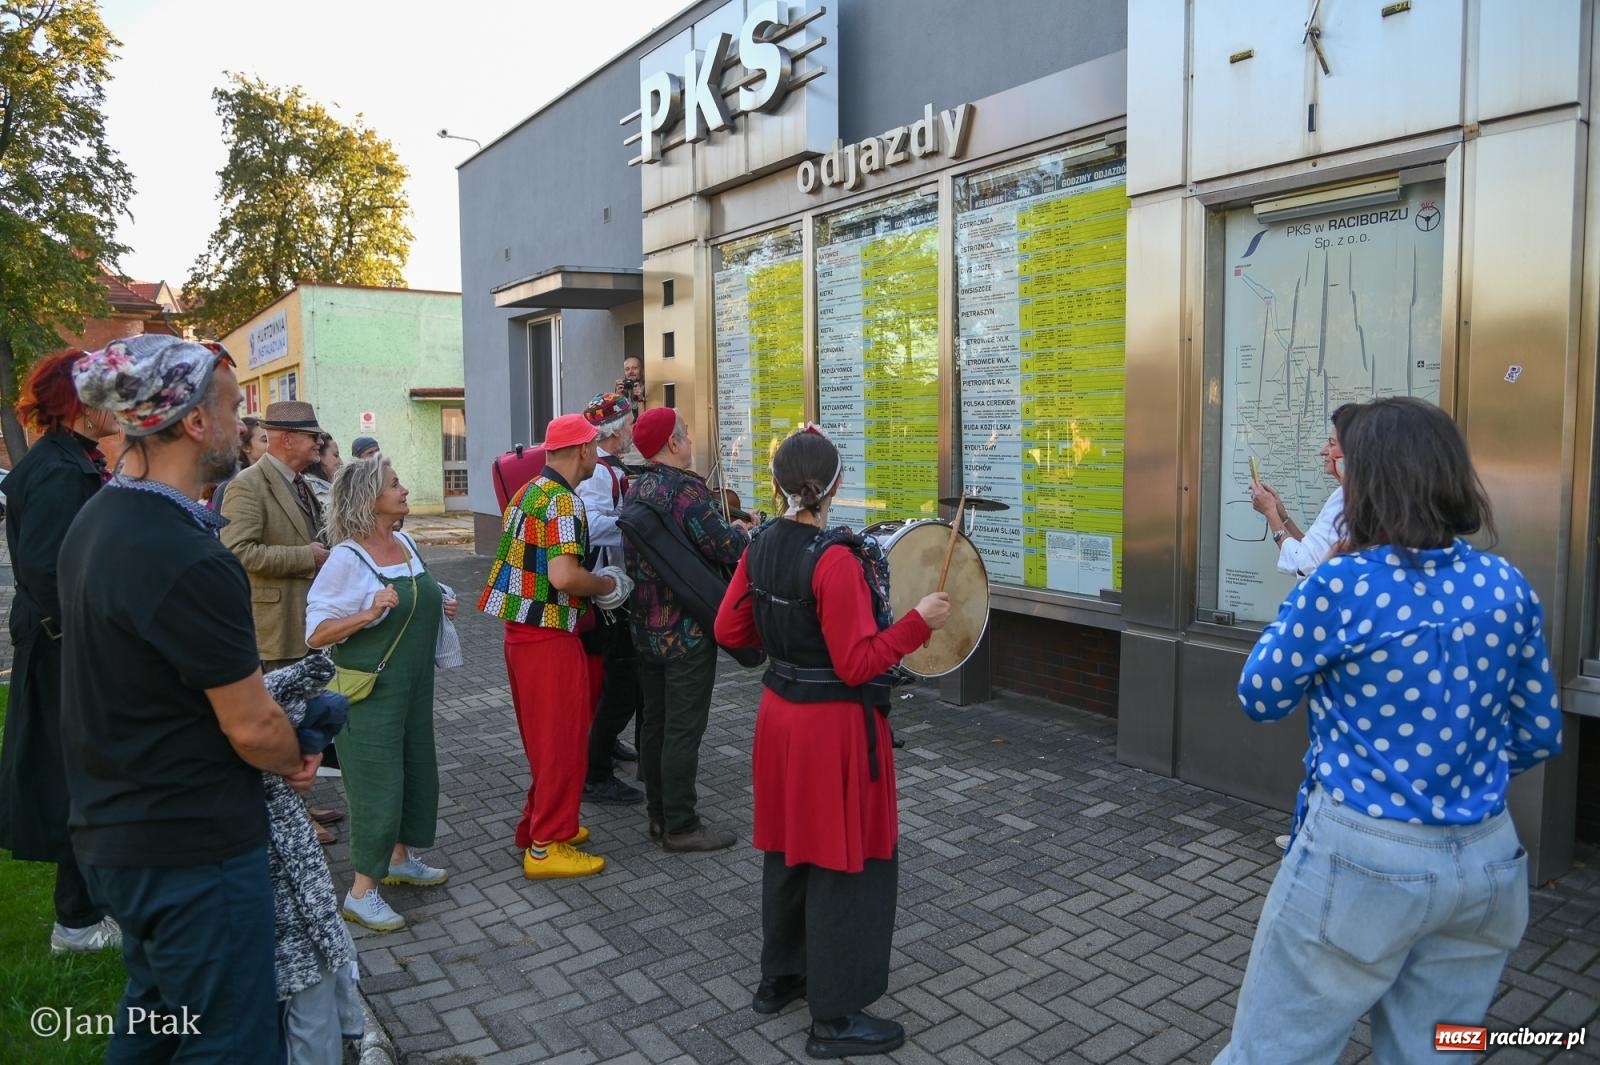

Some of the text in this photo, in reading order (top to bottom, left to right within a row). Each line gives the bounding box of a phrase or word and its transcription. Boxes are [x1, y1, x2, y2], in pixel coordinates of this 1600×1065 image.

[640, 0, 791, 164] PKS
[797, 102, 973, 193] odjazdy
[1061, 173, 1092, 188] GODZINY
[1094, 162, 1127, 180] ODJAZDÓ
[1287, 208, 1409, 237] PKS w RACIBORZU
[1314, 237, 1334, 250] Sp.
[1338, 237, 1344, 246] z
[965, 357, 995, 366] IETROWICE
